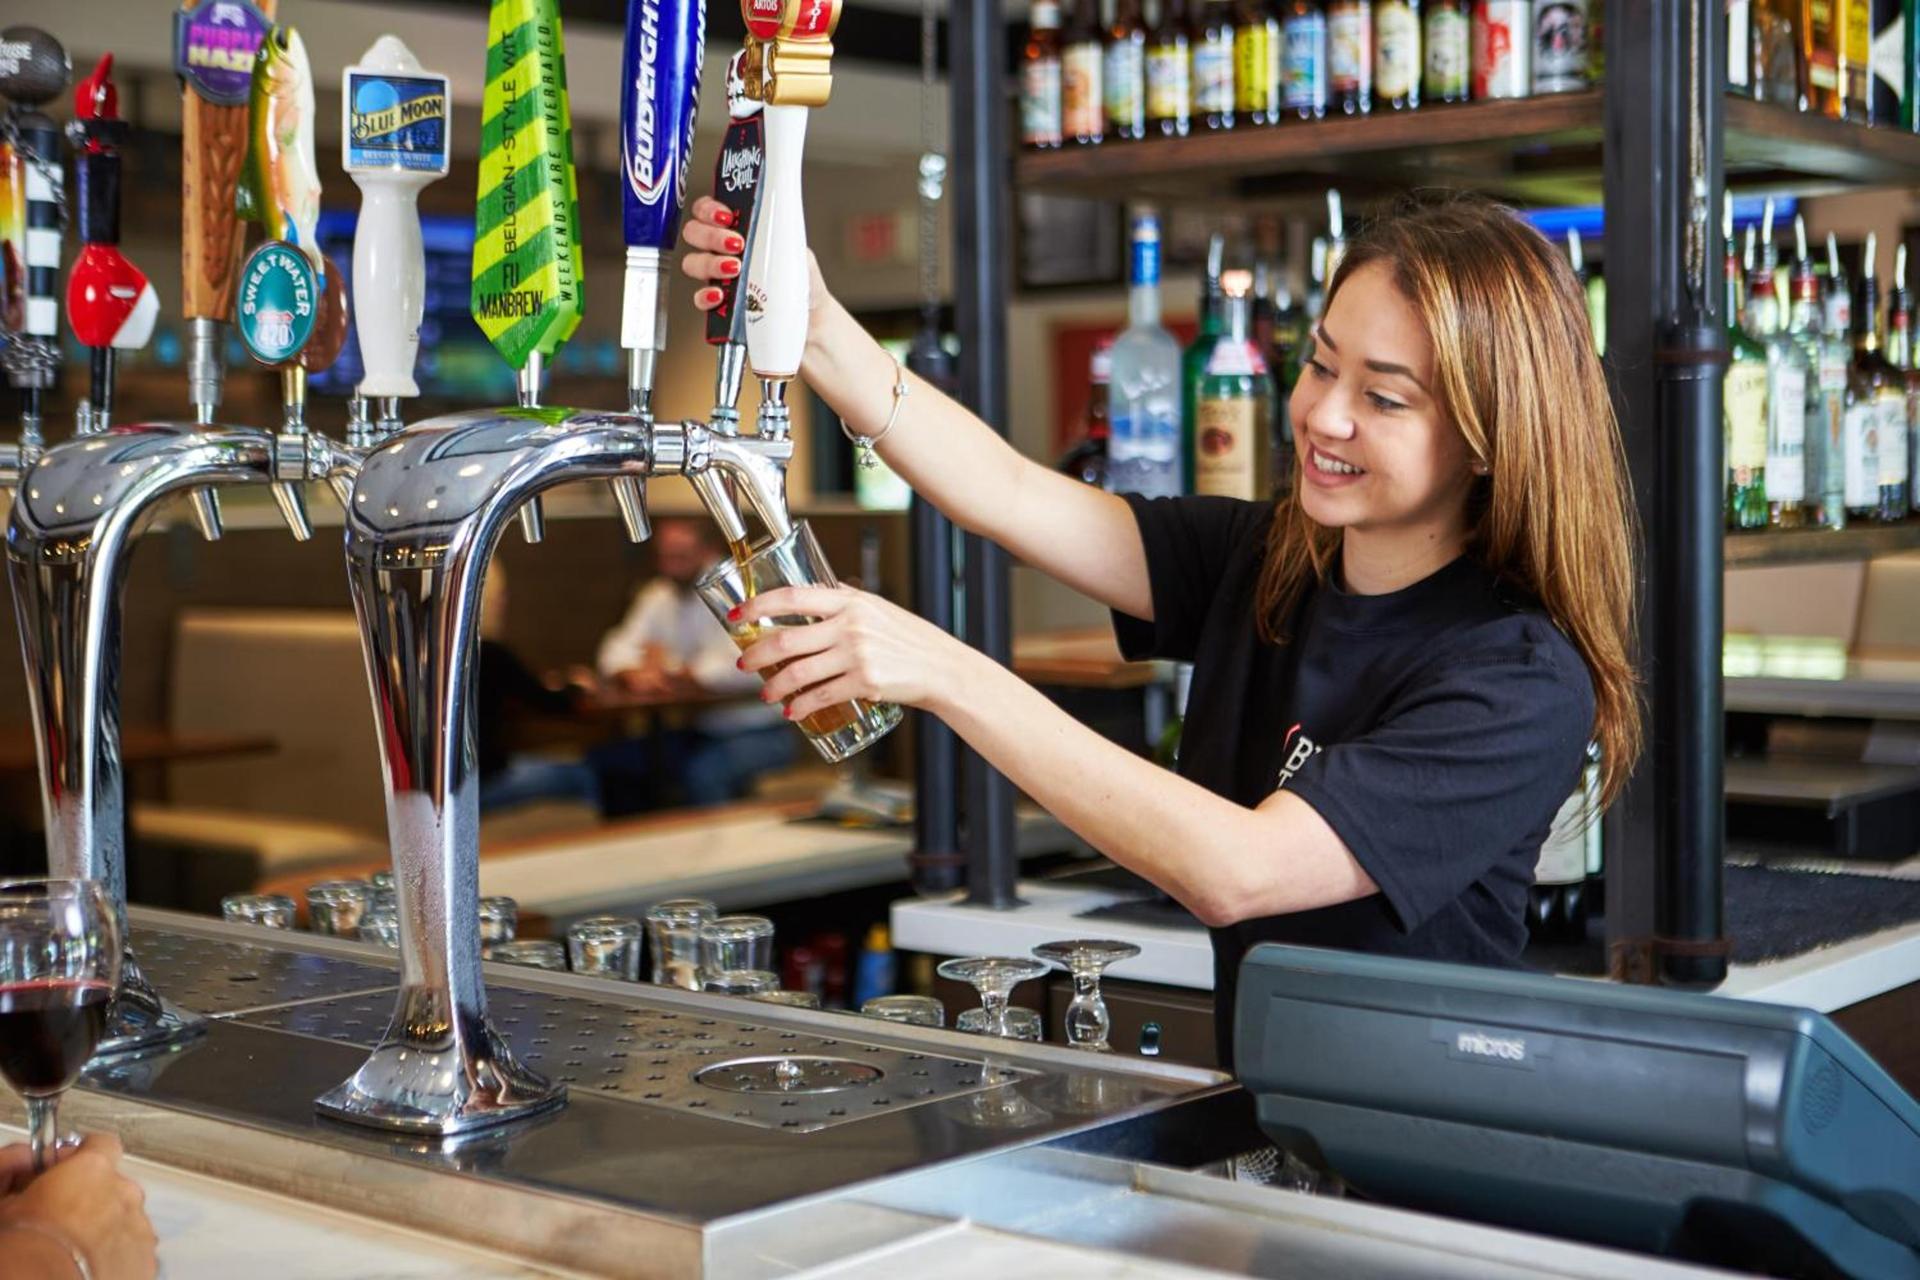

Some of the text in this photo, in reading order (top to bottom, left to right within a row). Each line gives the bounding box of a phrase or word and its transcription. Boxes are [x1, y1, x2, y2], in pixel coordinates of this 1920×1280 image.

[634, 0, 660, 190] BUD LIGH
[351, 99, 443, 140] BLUE MOON
[503, 79, 517, 254] BELGIAN-STYLE
[549, 151, 563, 185] ARE
[722, 146, 761, 178] LAUGHING
[725, 168, 758, 191] SKULL
[554, 201, 573, 302] WEEKENDS
[503, 263, 519, 290] FU
[1458, 1032, 1525, 1060] micros
